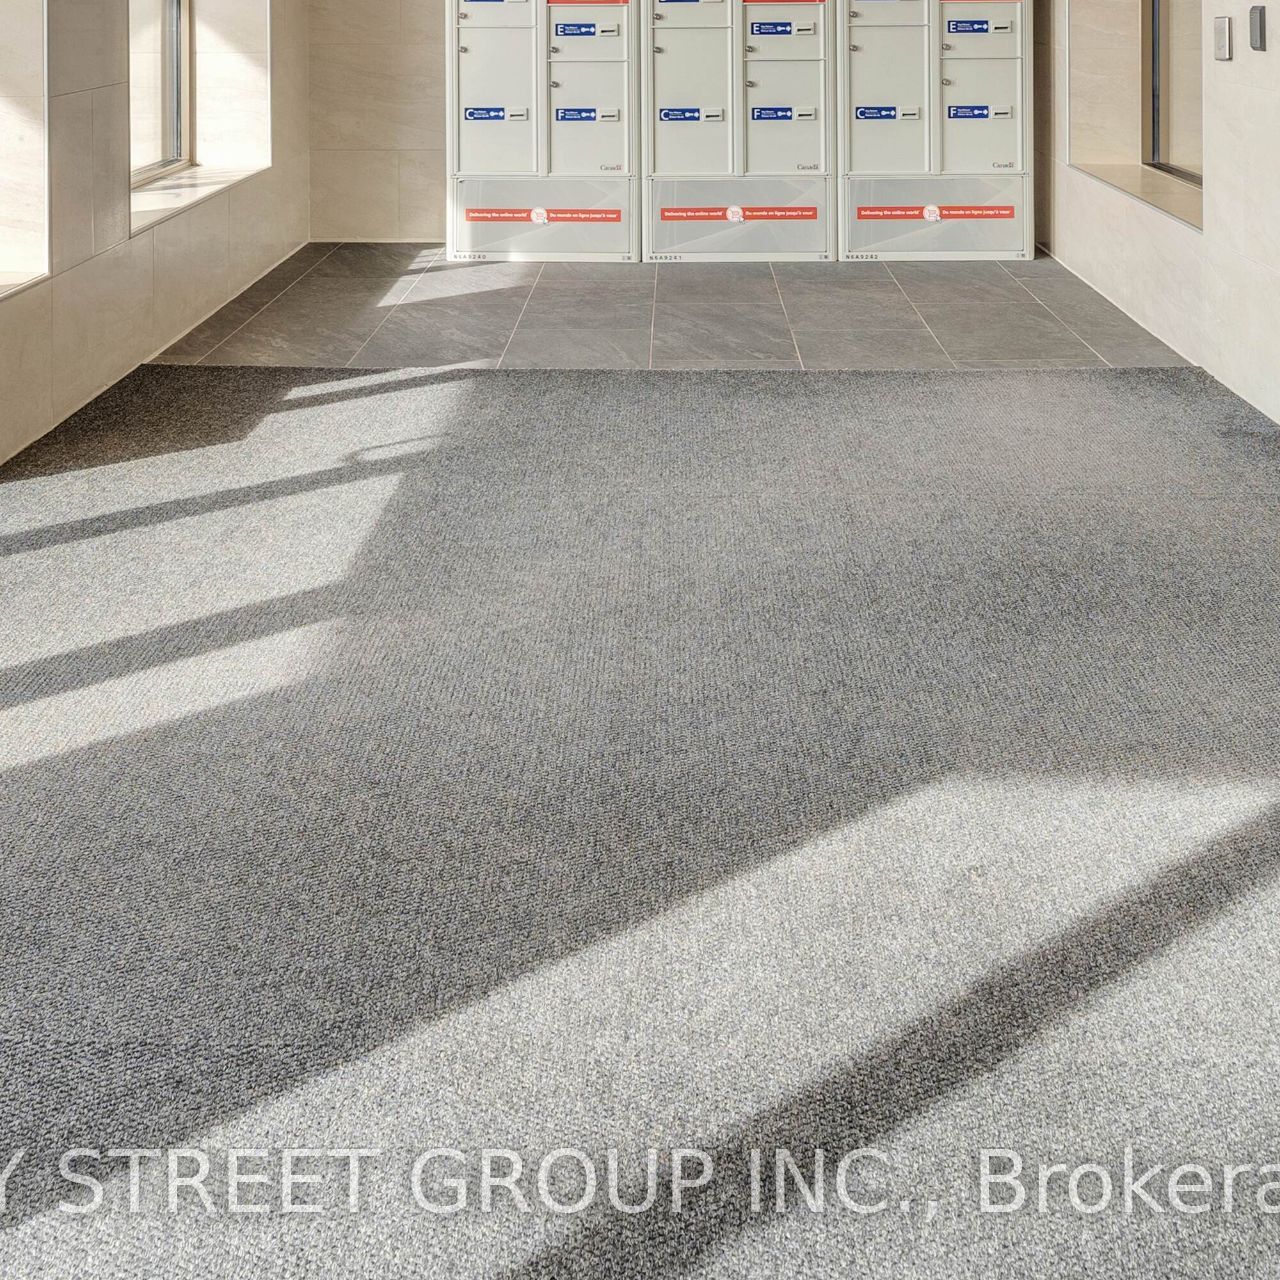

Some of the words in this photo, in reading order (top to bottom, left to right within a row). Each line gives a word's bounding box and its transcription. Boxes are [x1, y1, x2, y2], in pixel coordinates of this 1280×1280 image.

[558, 25, 564, 35] E
[753, 24, 760, 33] E
[950, 22, 956, 31] E
[466, 109, 474, 119] C
[558, 110, 564, 119] F
[661, 110, 669, 120] C
[754, 109, 760, 119] F
[857, 108, 865, 118] C
[950, 108, 956, 117] F
